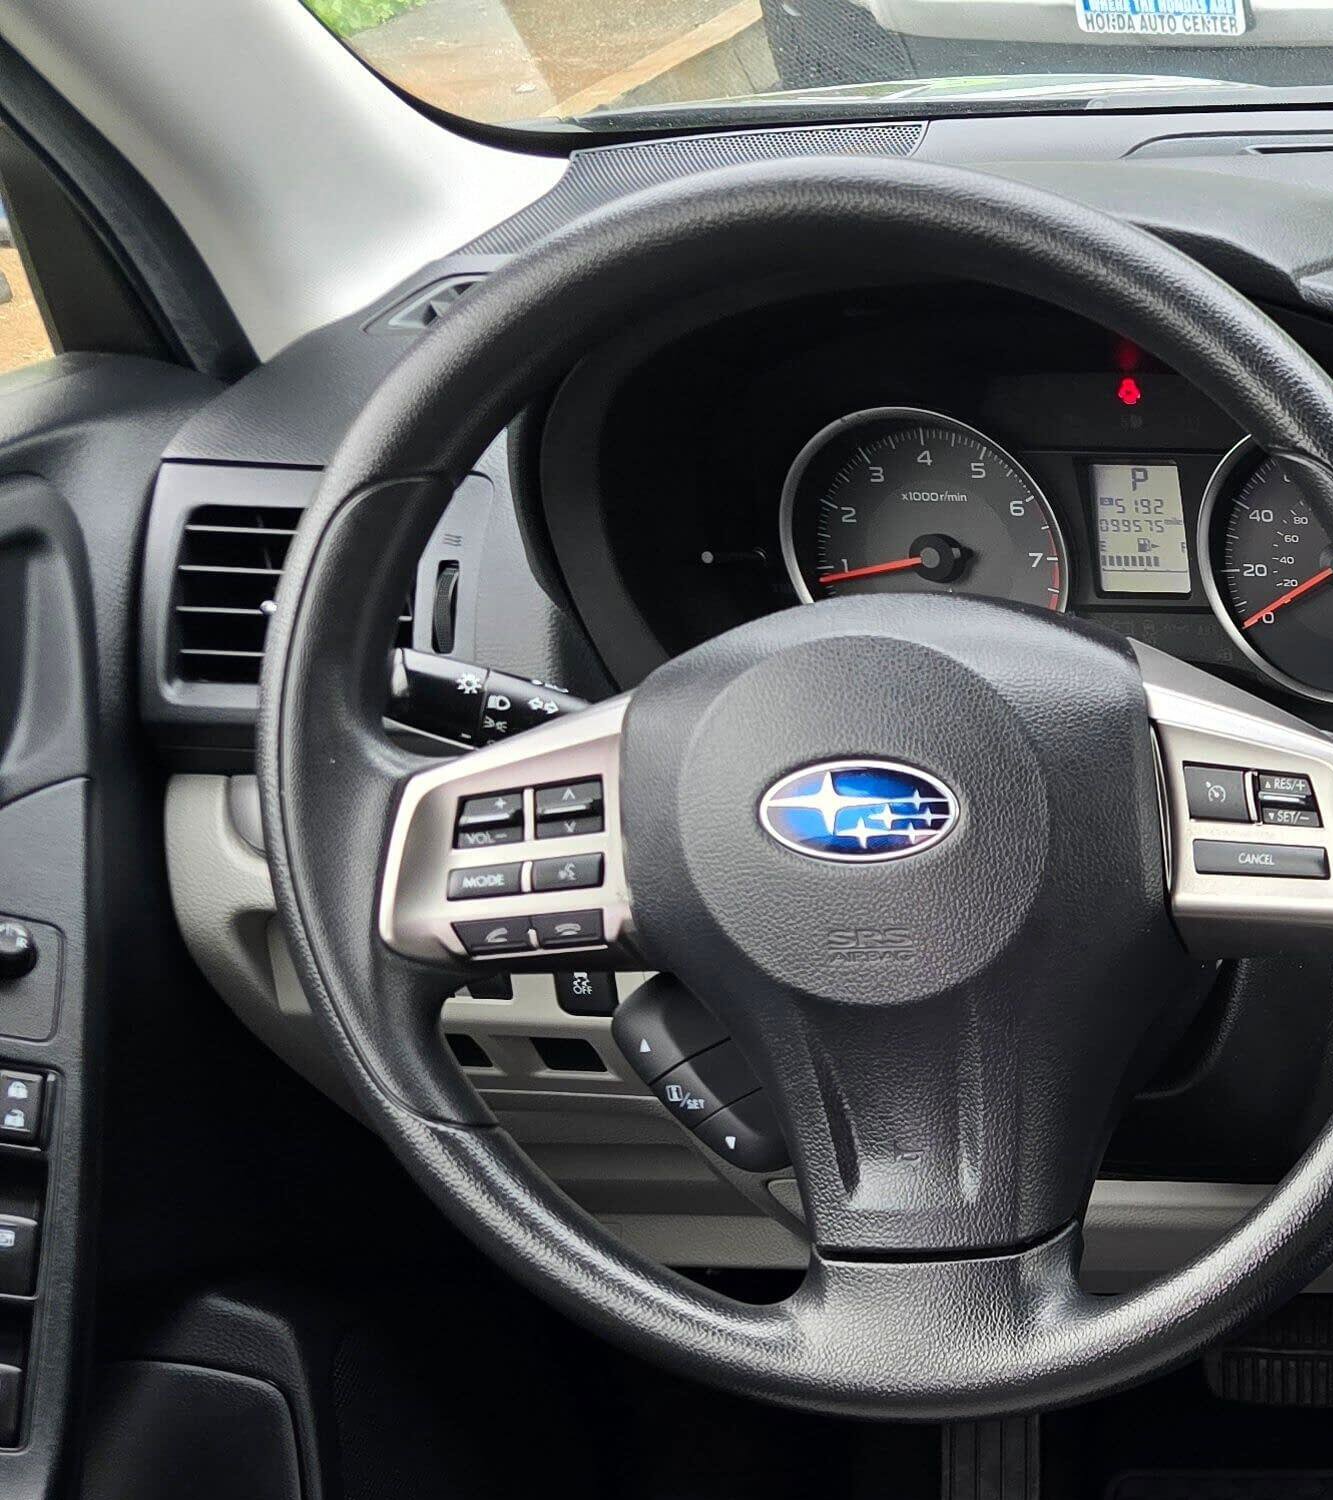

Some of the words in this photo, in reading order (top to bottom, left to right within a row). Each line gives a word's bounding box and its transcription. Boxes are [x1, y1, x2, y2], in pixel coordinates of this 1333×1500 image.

[1085, 13, 1136, 31] HONDA
[1140, 15, 1177, 32] AUTO
[1183, 15, 1238, 33] CENTER
[917, 450, 932, 466] 4
[869, 467, 884, 482] 3
[971, 463, 985, 478] 5
[1131, 468, 1148, 491] P
[841, 507, 856, 522] 2
[1010, 501, 1024, 516] 6
[1249, 510, 1273, 523] 40
[1293, 517, 1308, 525] 80
[1284, 535, 1299, 543] 60
[841, 558, 848, 572] 1
[1029, 552, 1043, 568] 7
[1280, 557, 1295, 565] 40
[1243, 564, 1268, 577] 20
[1283, 579, 1298, 588] 20
[1262, 612, 1274, 624] 0
[1238, 852, 1275, 865] CANCEL
[462, 873, 505, 888] MODE
[827, 928, 913, 950] SRS
[573, 985, 592, 995] OFF
